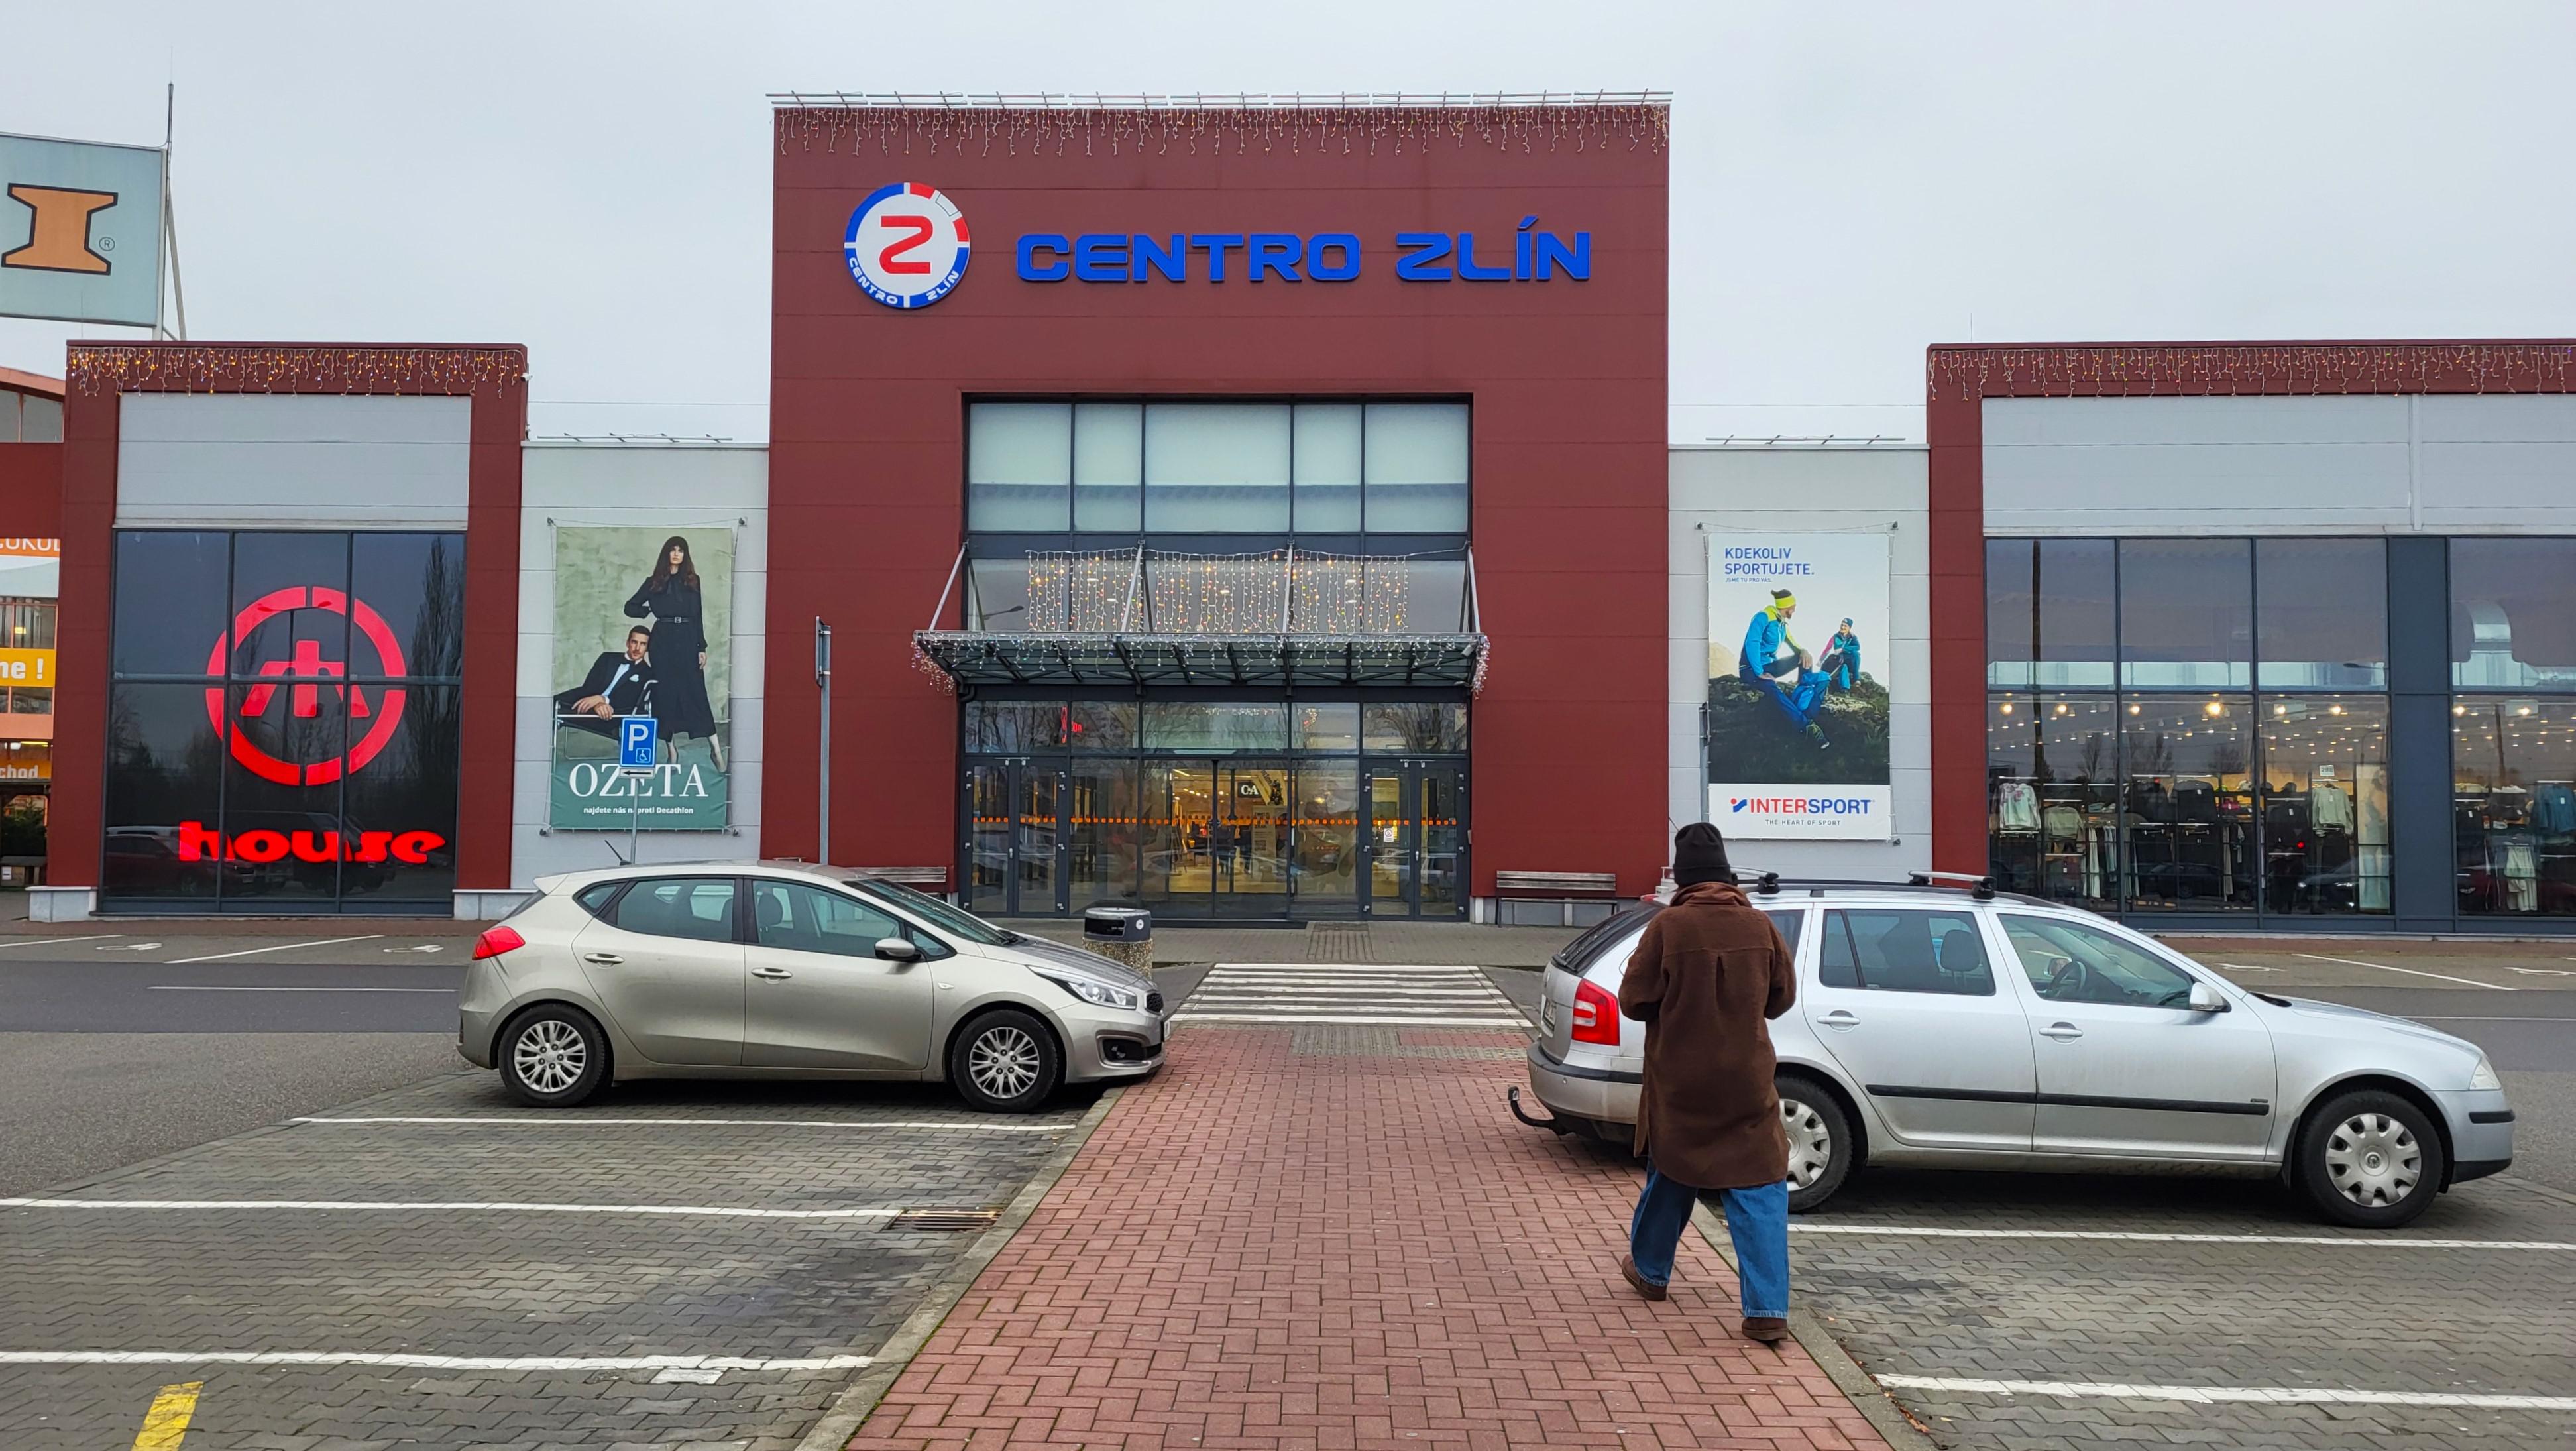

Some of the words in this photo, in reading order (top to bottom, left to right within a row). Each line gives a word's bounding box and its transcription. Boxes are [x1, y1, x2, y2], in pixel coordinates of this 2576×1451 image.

[1017, 233, 1361, 282] CENTRO
[1395, 215, 1591, 282] ZLÍN
[849, 257, 899, 305] CENTRO
[926, 270, 960, 301] ZLÍN
[1725, 548, 1792, 559] KDEKOLIV
[1724, 563, 1815, 575] SPORTUJETE.
[628, 724, 649, 752] P
[583, 806, 611, 815] najdete
[1750, 798, 1872, 815] INTERSPORT
[179, 821, 446, 864] house
